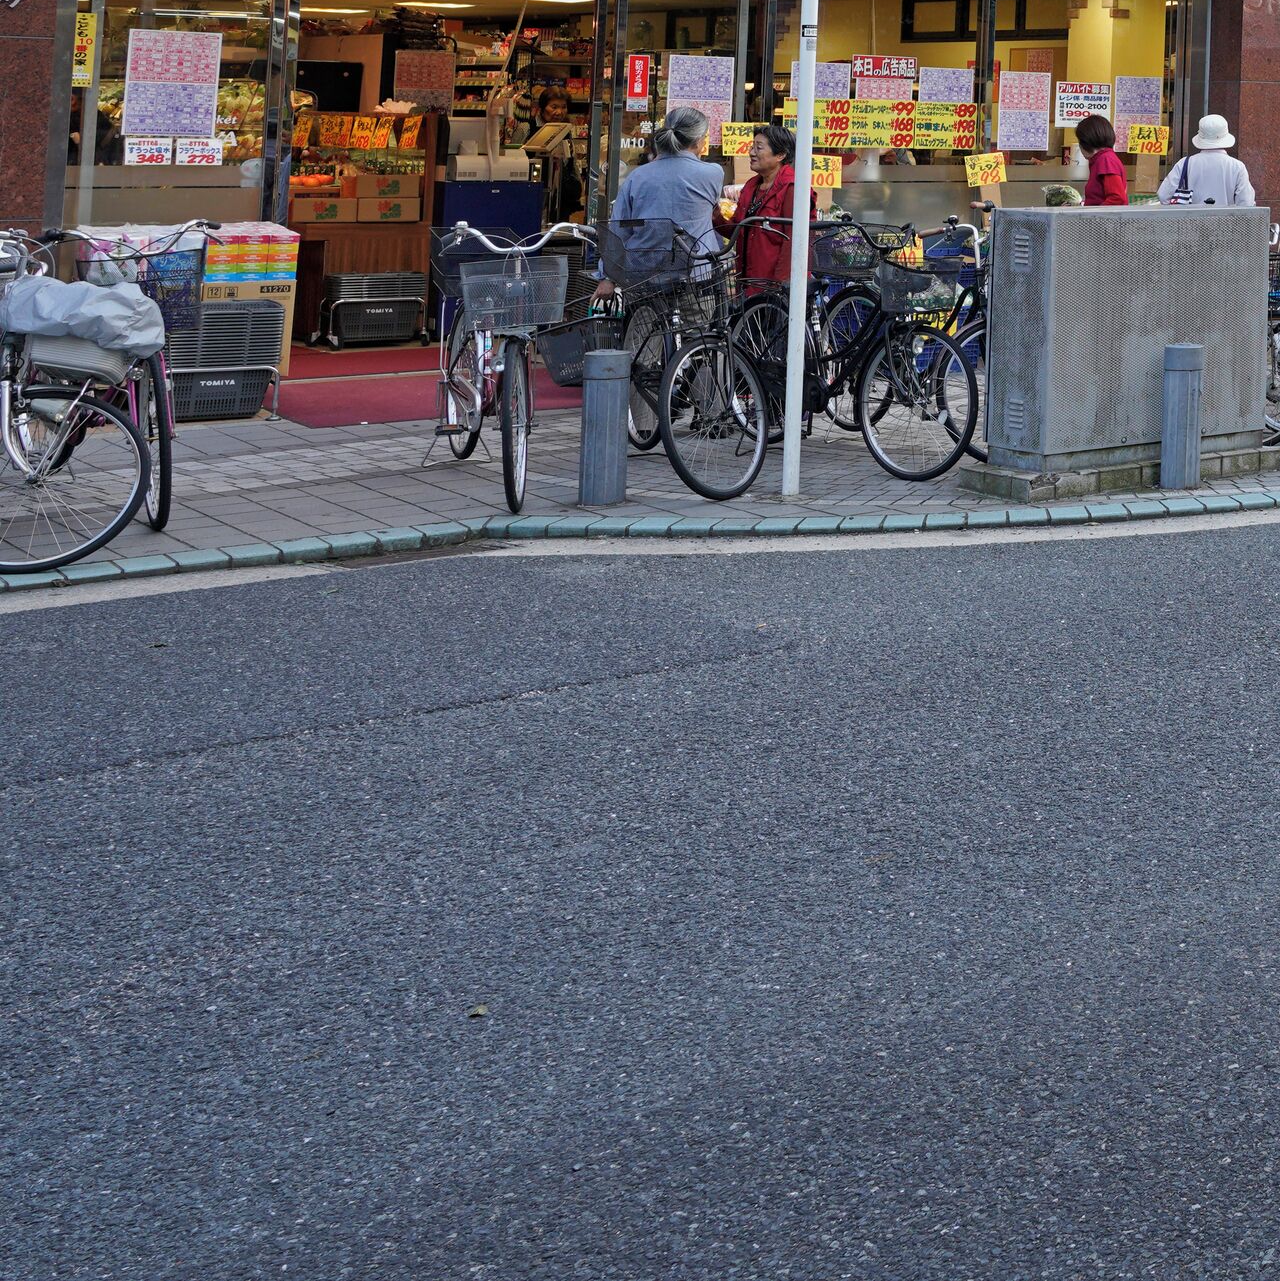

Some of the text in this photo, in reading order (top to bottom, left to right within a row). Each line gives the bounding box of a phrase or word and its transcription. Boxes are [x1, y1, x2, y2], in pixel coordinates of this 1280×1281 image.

[853, 56, 916, 77] 本日の広告商品
[1059, 84, 1110, 95] アルバイト募集
[1139, 141, 1164, 153] 198
[135, 153, 166, 164] 348
[186, 154, 216, 164] 278
[209, 287, 219, 296] 12
[261, 285, 290, 293] 41270
[200, 379, 236, 387] TOMIYA
